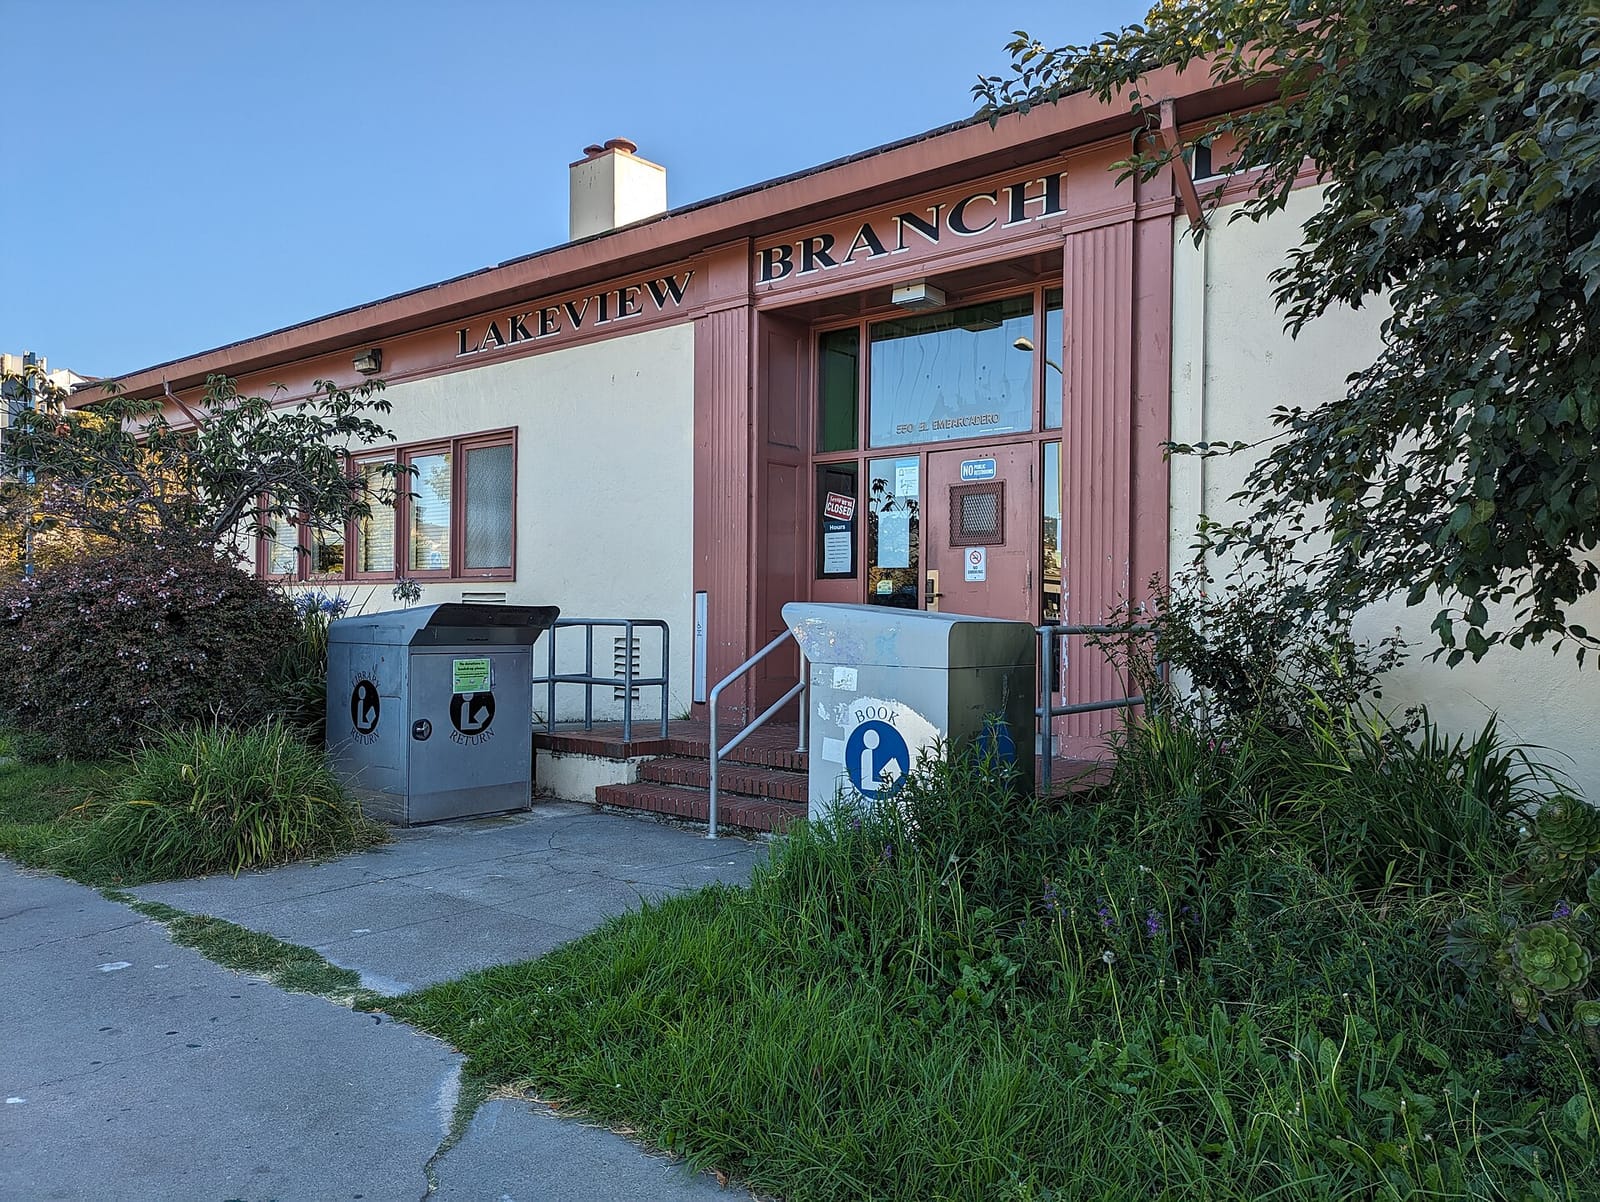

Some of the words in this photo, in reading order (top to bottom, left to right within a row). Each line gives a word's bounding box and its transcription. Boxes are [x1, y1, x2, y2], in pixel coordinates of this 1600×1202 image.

[755, 172, 1068, 286] BRANCH
[455, 270, 695, 358] LAKEVIEW
[896, 423, 914, 435] 550
[932, 413, 1000, 431] EMBARCADERO
[962, 464, 974, 477] NO
[826, 502, 853, 517] CLOSED
[829, 524, 846, 532] Hours
[351, 670, 381, 689] LIBRARY
[854, 706, 899, 727] BOOK
[350, 727, 380, 746] RETURN
[449, 727, 495, 746] RETURN
